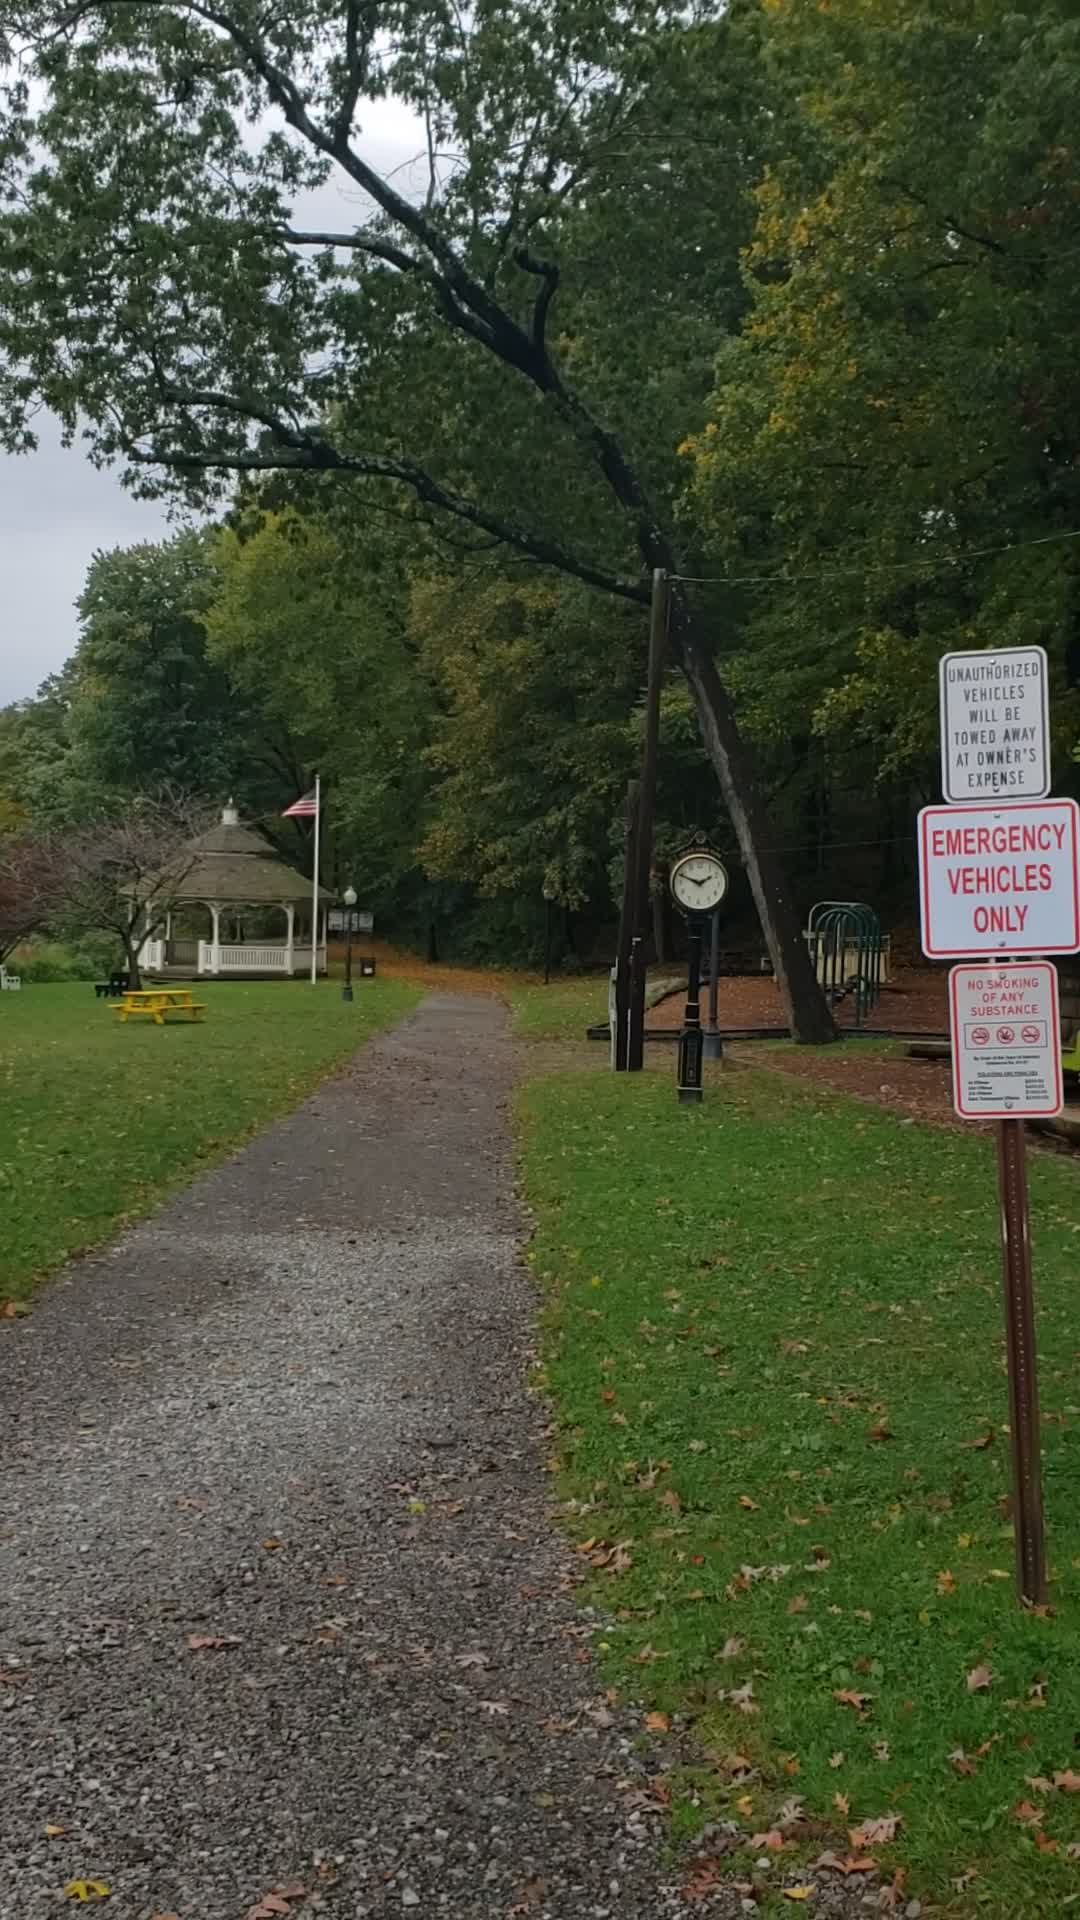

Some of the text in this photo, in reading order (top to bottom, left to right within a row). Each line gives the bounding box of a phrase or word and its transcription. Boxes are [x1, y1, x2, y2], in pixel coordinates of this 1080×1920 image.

[949, 662, 1039, 683] UNAUTHORIZED
[963, 685, 1025, 703] VEHICLES
[969, 706, 1021, 723] WILL BE
[954, 726, 1037, 745] TOWED AWAY
[956, 748, 1037, 767] AT OWNER'S
[968, 770, 1025, 787] EXPENSE
[932, 823, 1066, 856] EMERGENCY
[947, 863, 1052, 895] VEHICLES
[973, 905, 1028, 933] ONLY
[967, 977, 1040, 990] NO SMOKING
[982, 991, 1025, 1002] OF ANY
[970, 1004, 1040, 1017] SUBSTANCE
